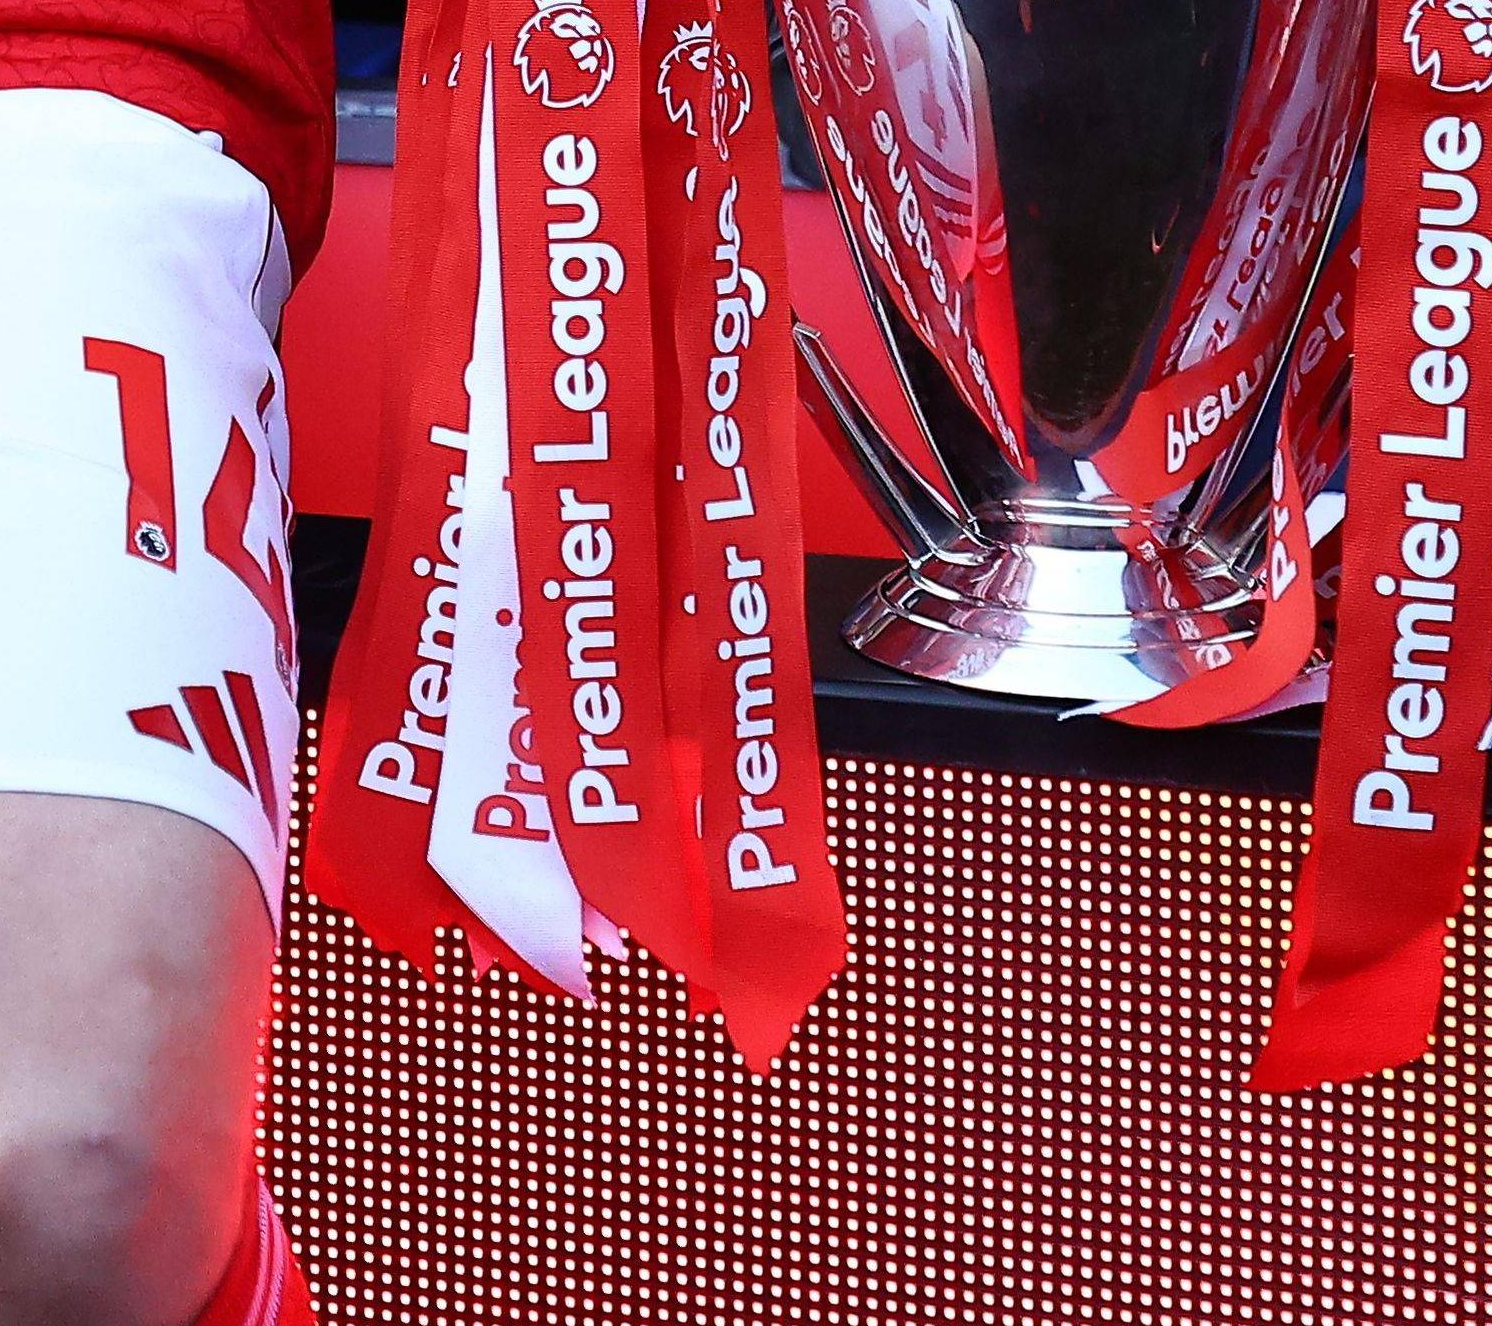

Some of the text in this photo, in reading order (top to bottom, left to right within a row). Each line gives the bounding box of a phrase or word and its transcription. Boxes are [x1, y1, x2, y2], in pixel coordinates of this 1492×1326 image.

[532, 132, 642, 826] Premier League
[705, 175, 798, 892] Premier League
[1352, 481, 1465, 833] Premier
